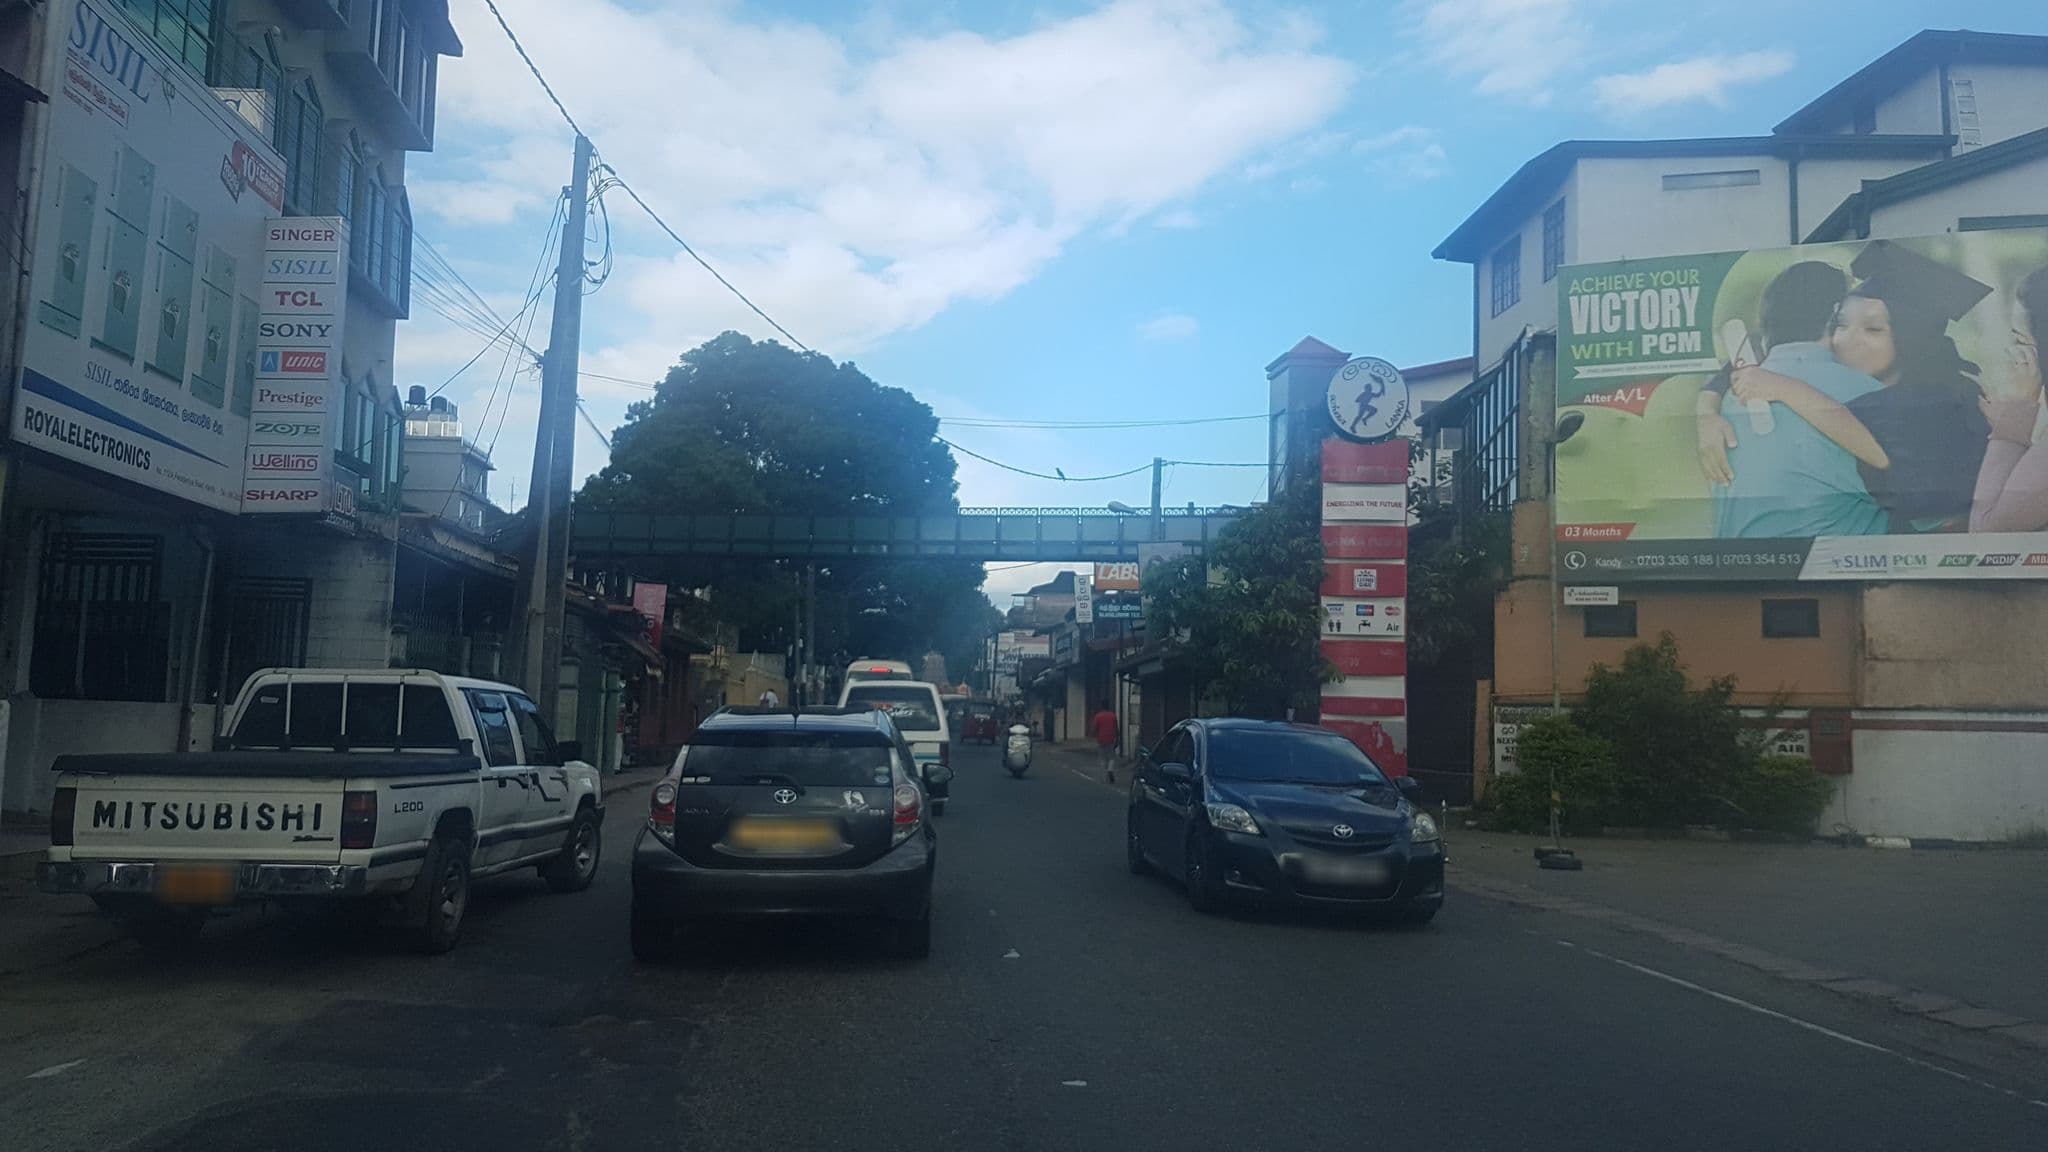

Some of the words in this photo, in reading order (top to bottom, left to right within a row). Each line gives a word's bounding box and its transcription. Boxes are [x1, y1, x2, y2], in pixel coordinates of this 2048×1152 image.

[69, 0, 150, 104] SISIL
[270, 228, 335, 241] SINGER
[267, 259, 333, 275] SISIL
[1569, 272, 1646, 294] ACHIEVE
[1650, 269, 1700, 286] YOUR
[274, 290, 323, 307] TCL
[1569, 286, 1700, 335] VICTORY
[259, 322, 333, 338] SONY
[1571, 341, 1633, 360] WITH
[1641, 331, 1701, 355] PCM
[258, 389, 323, 407] Prestige
[1584, 394, 1612, 404] After
[1614, 388, 1646, 403] A/L
[1385, 400, 1405, 429] LANKA
[254, 422, 321, 437] ZOJE
[23, 406, 151, 471] ROYALELECTRONICS
[252, 453, 319, 472] Welling
[246, 489, 319, 501] SHARP
[1366, 500, 1378, 508] THE
[1564, 526, 1580, 537] 03
[1583, 527, 1623, 537] Months
[1595, 557, 1622, 569] Kandy
[1636, 555, 1665, 566] 0703
[1722, 554, 1751, 565] 0703
[1754, 553, 1776, 565] 354
[1778, 553, 1801, 564] 513
[1844, 554, 1887, 568] SLIM
[1892, 554, 1928, 567] PCM
[1945, 556, 1968, 565] PCM
[1387, 623, 1399, 632] Air
[394, 801, 423, 813] L200
[92, 800, 323, 831] MITSUBISHI
